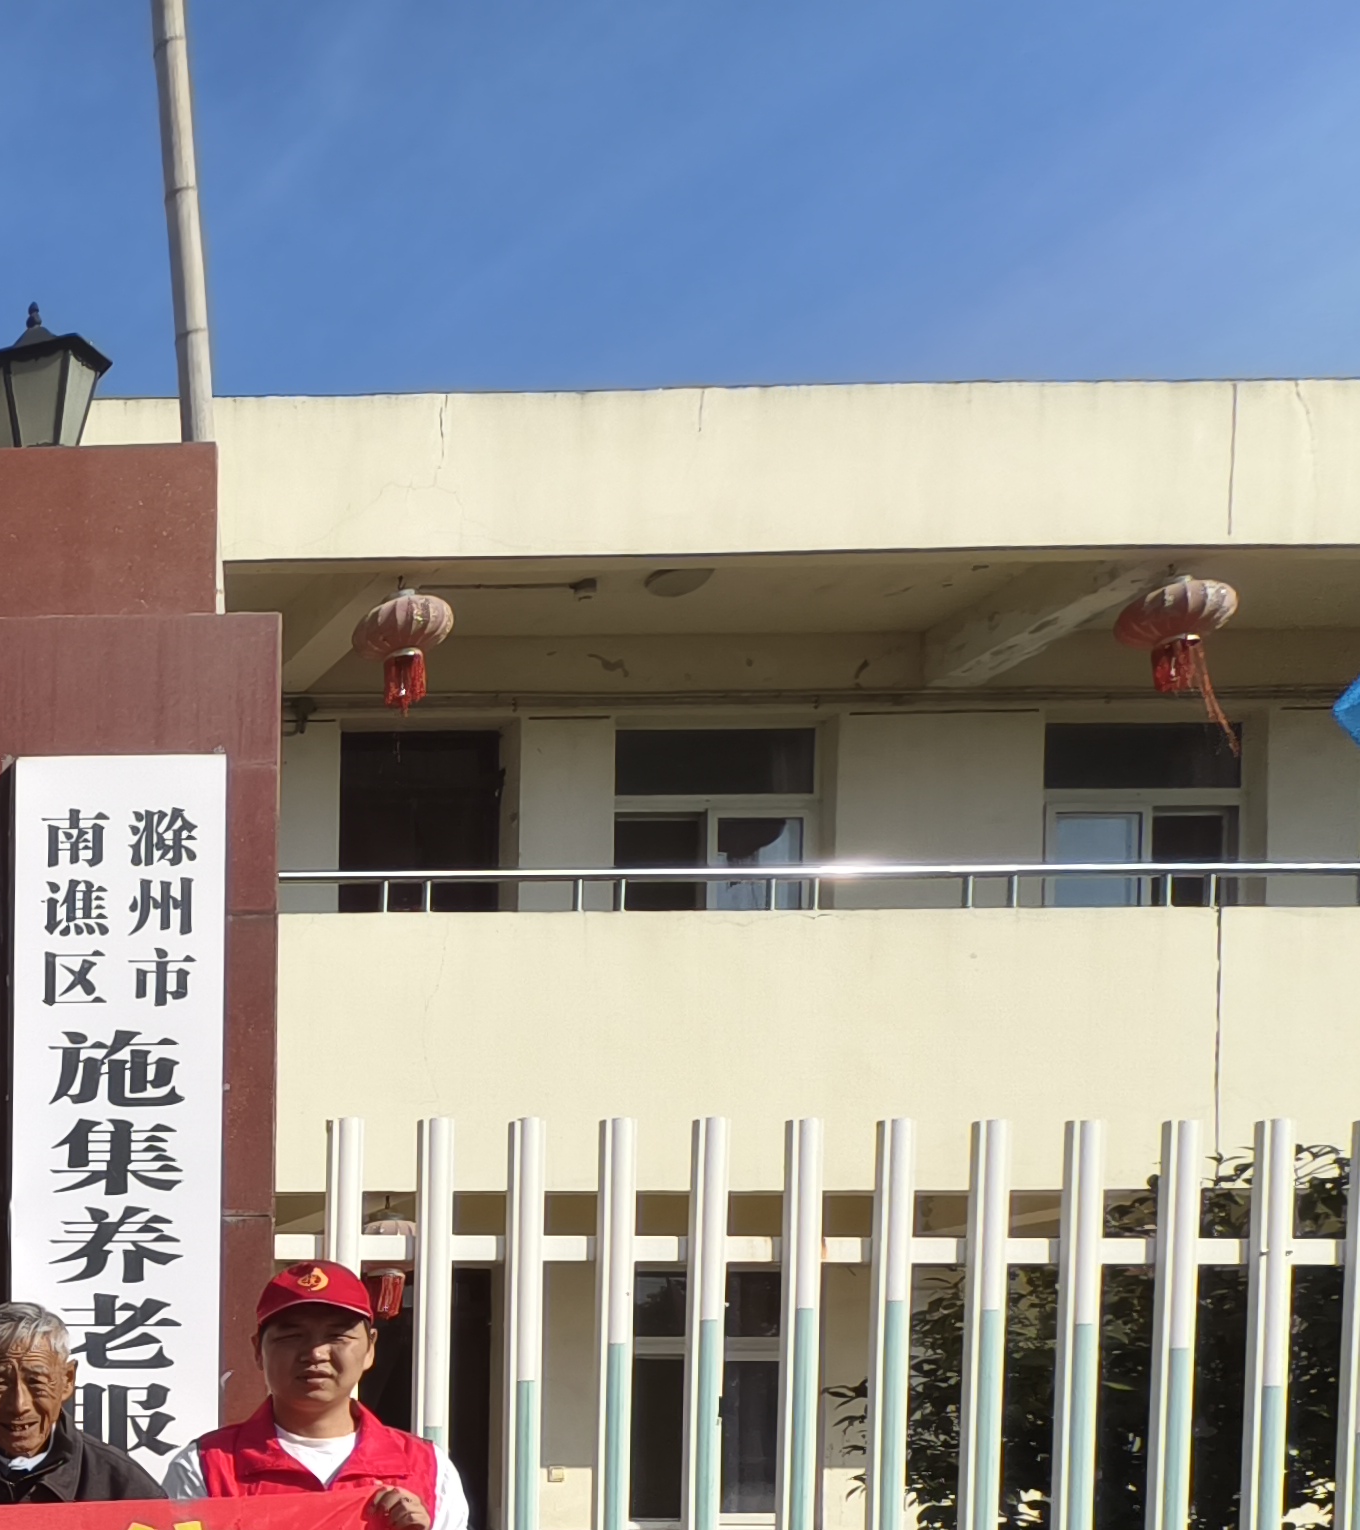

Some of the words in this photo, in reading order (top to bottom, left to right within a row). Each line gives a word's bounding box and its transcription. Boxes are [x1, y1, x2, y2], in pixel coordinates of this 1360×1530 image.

[40, 807, 110, 1007] 南谯区
[127, 806, 198, 1007] 滁州市
